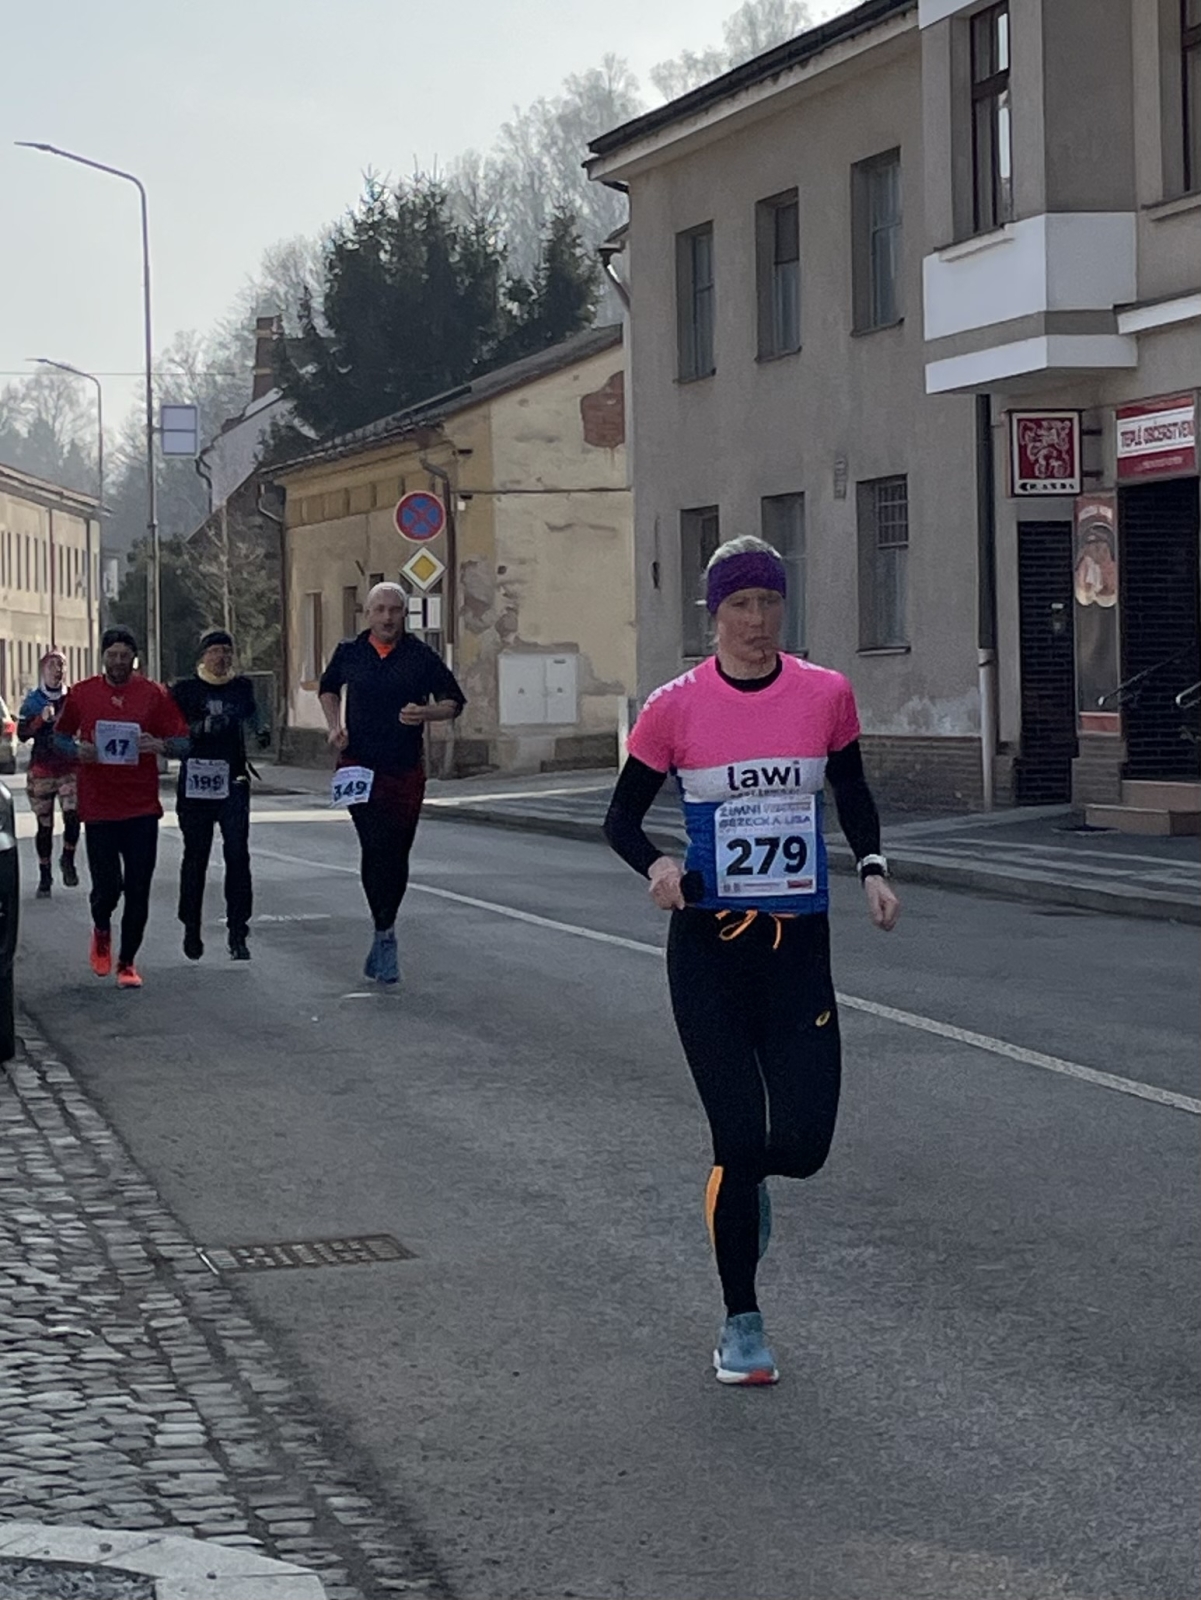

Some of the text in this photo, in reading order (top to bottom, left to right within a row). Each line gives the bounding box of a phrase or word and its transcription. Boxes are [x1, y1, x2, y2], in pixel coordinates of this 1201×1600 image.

[105, 739, 130, 756] 47
[727, 760, 802, 791] lawi
[334, 781, 367, 802] 349
[726, 835, 808, 876] 279
